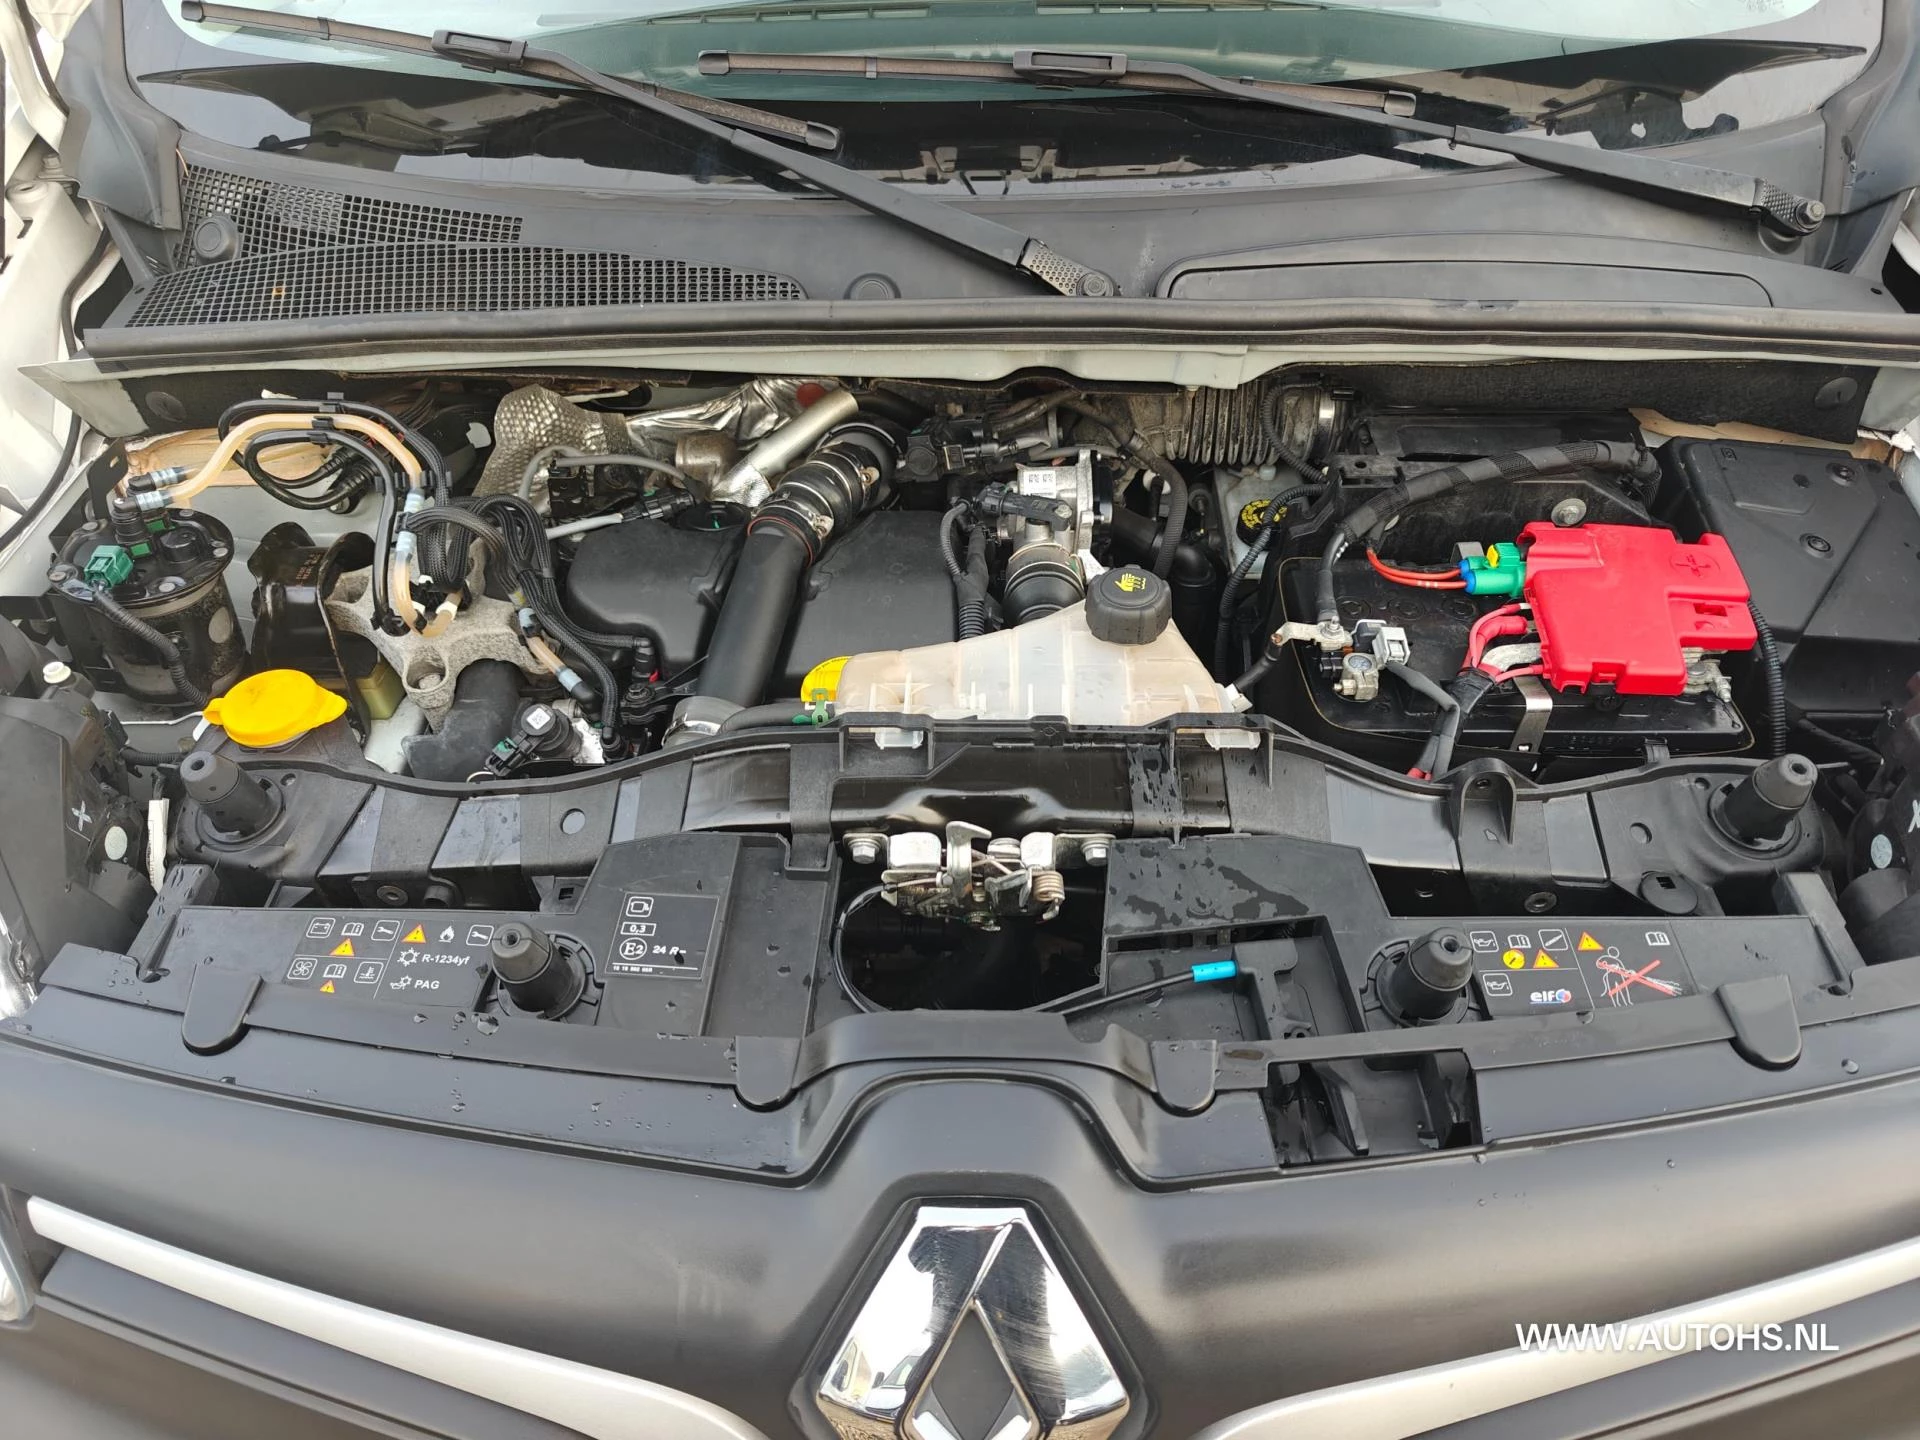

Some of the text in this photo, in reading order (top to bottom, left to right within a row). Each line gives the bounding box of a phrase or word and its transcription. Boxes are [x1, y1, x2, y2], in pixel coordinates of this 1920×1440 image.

[629, 924, 647, 935] 0,3
[623, 942, 644, 956] E2
[652, 945, 667, 954] 24
[421, 953, 471, 967] R-1234yf
[414, 979, 440, 990] PAG
[1530, 990, 1555, 1003] elf
